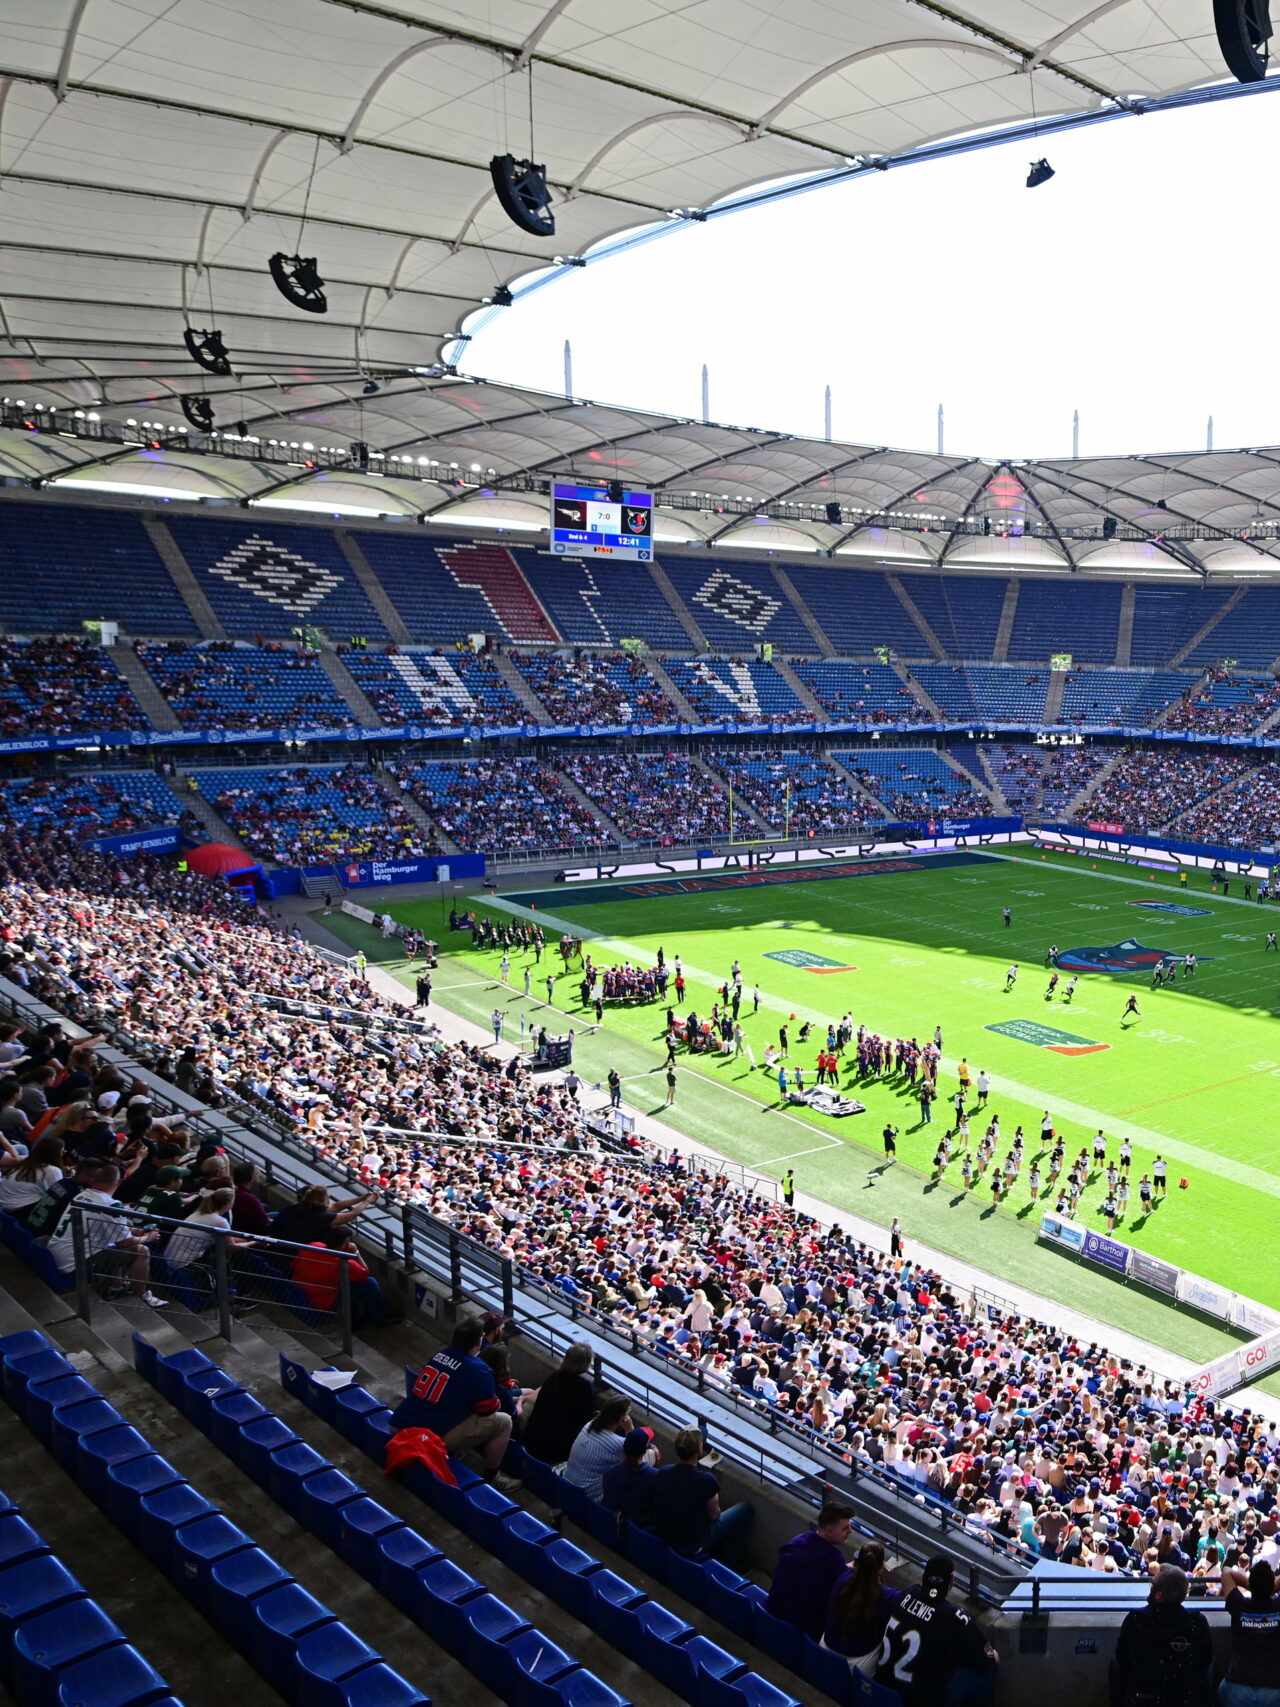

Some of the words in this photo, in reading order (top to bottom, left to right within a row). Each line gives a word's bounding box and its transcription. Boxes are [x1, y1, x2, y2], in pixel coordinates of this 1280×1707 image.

[618, 537, 639, 546] 12:41
[372, 865, 418, 874] Hamburger
[1246, 1345, 1268, 1366] GO!
[411, 1365, 450, 1404] 91
[907, 1599, 936, 1622] LEWIS
[1240, 1619, 1279, 1629] patagonia
[878, 1616, 921, 1682] 52
